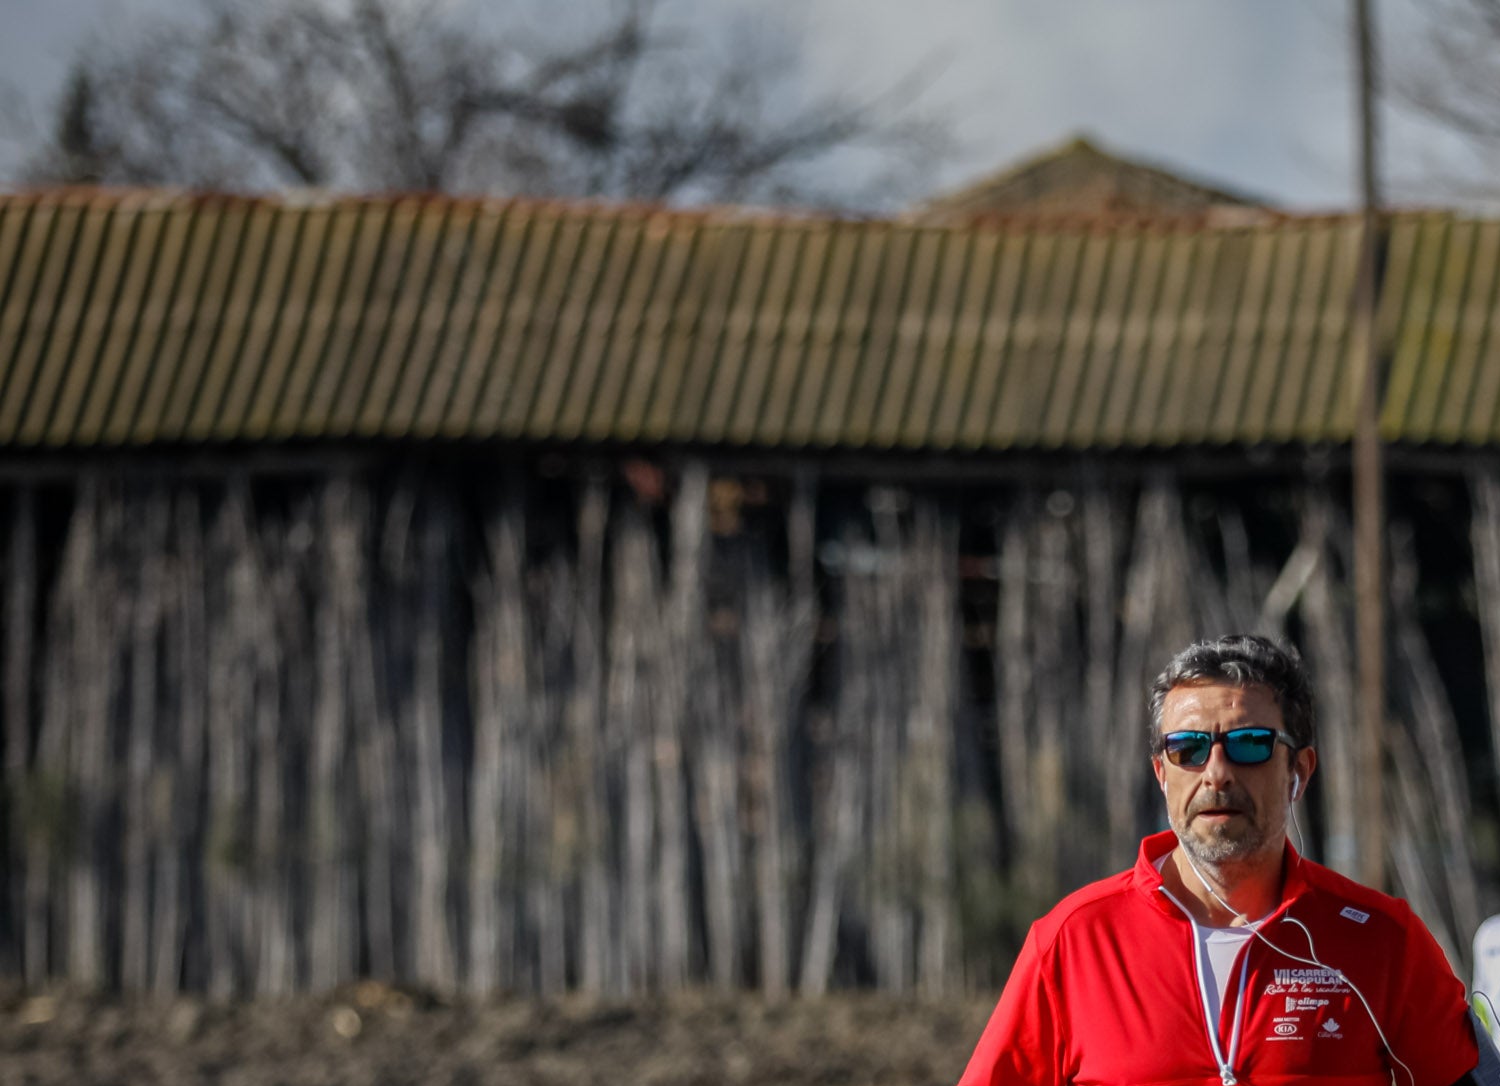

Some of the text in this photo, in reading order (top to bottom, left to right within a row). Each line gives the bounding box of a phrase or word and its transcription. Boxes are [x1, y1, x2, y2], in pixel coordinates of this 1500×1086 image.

[1274, 969, 1290, 985] VII
[1291, 969, 1342, 977] CARRERA
[1291, 977, 1343, 985] POPULAR
[1297, 997, 1330, 1007] olimpo
[1278, 1025, 1294, 1033] KIA
